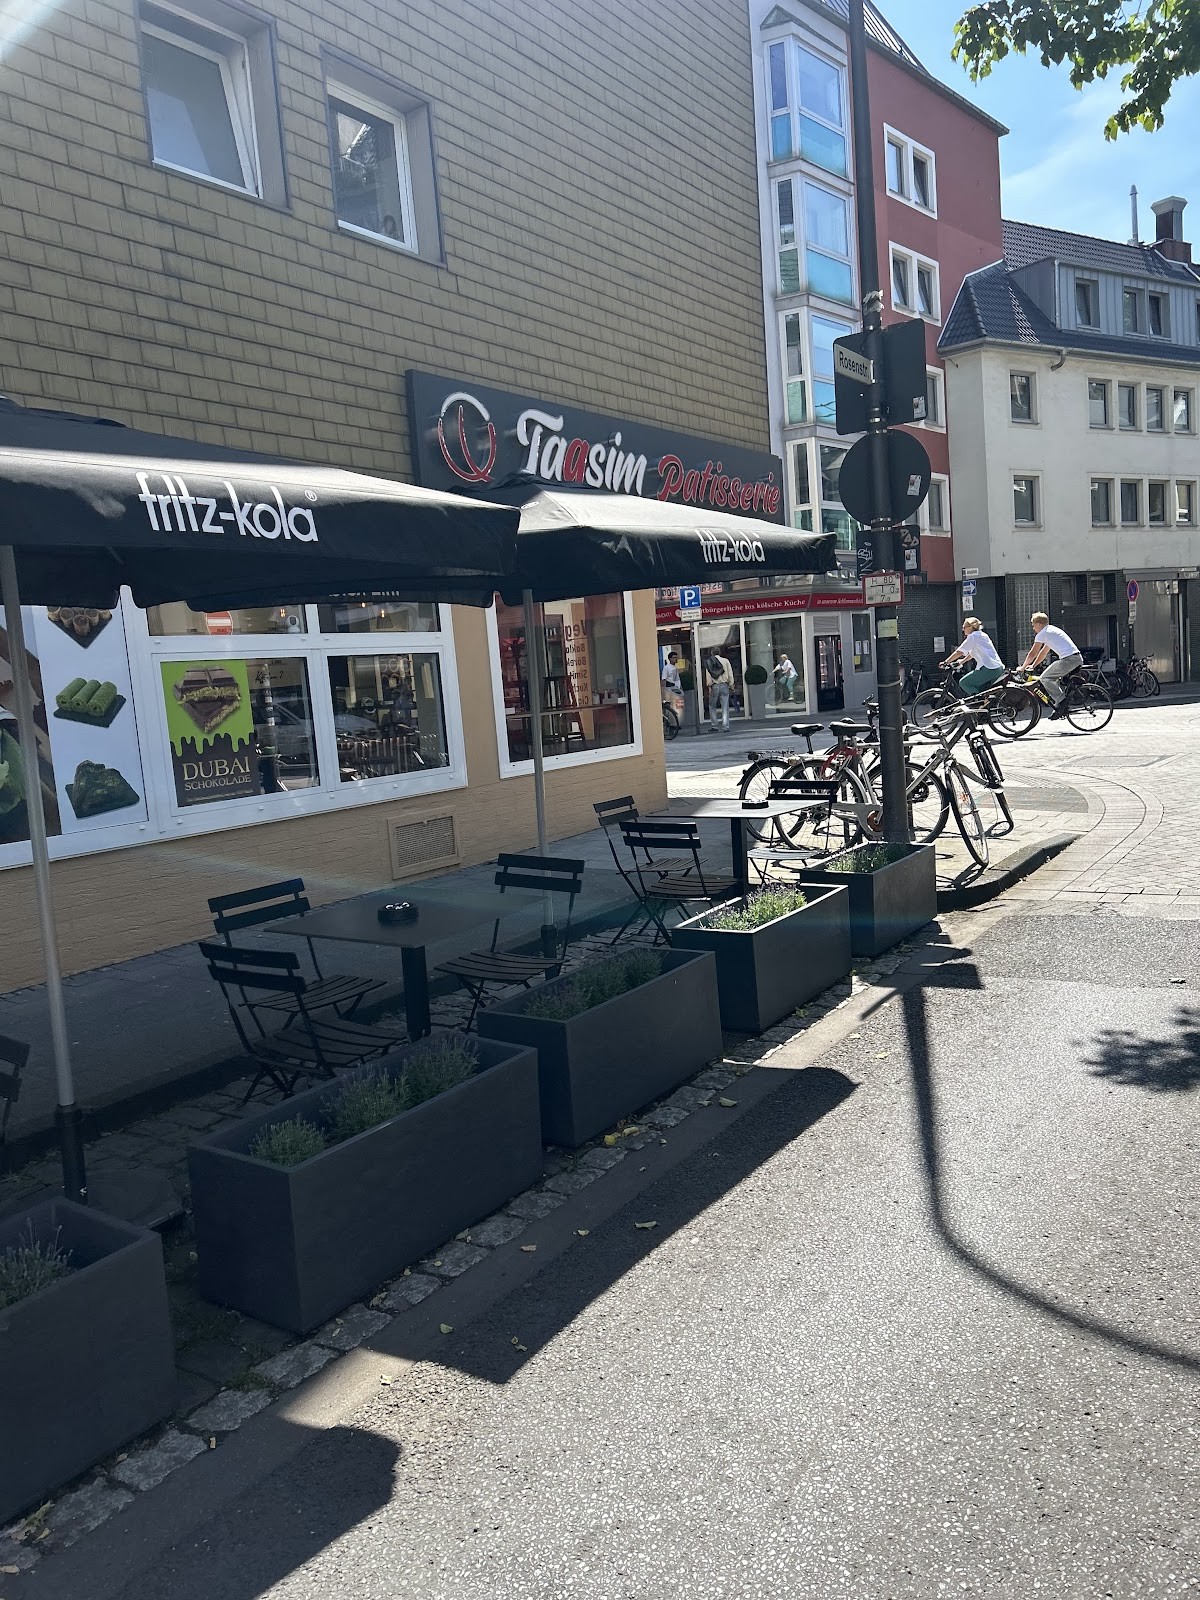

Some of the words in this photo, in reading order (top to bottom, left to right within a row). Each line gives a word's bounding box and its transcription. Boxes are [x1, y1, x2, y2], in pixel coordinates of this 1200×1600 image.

[839, 351, 871, 379] Rosenstr.
[516, 408, 648, 496] Taasim
[656, 454, 781, 514] Patisserie
[136, 471, 319, 542] fritz-kola
[694, 529, 766, 563] fritz-kola
[684, 589, 696, 607] P
[701, 602, 743, 615] tbürgerliche
[744, 603, 756, 611] bis
[756, 599, 783, 610] kölsche
[783, 598, 806, 608] Küche
[182, 756, 252, 781] DUBAI
[184, 774, 252, 791] SCHOKOLADE
